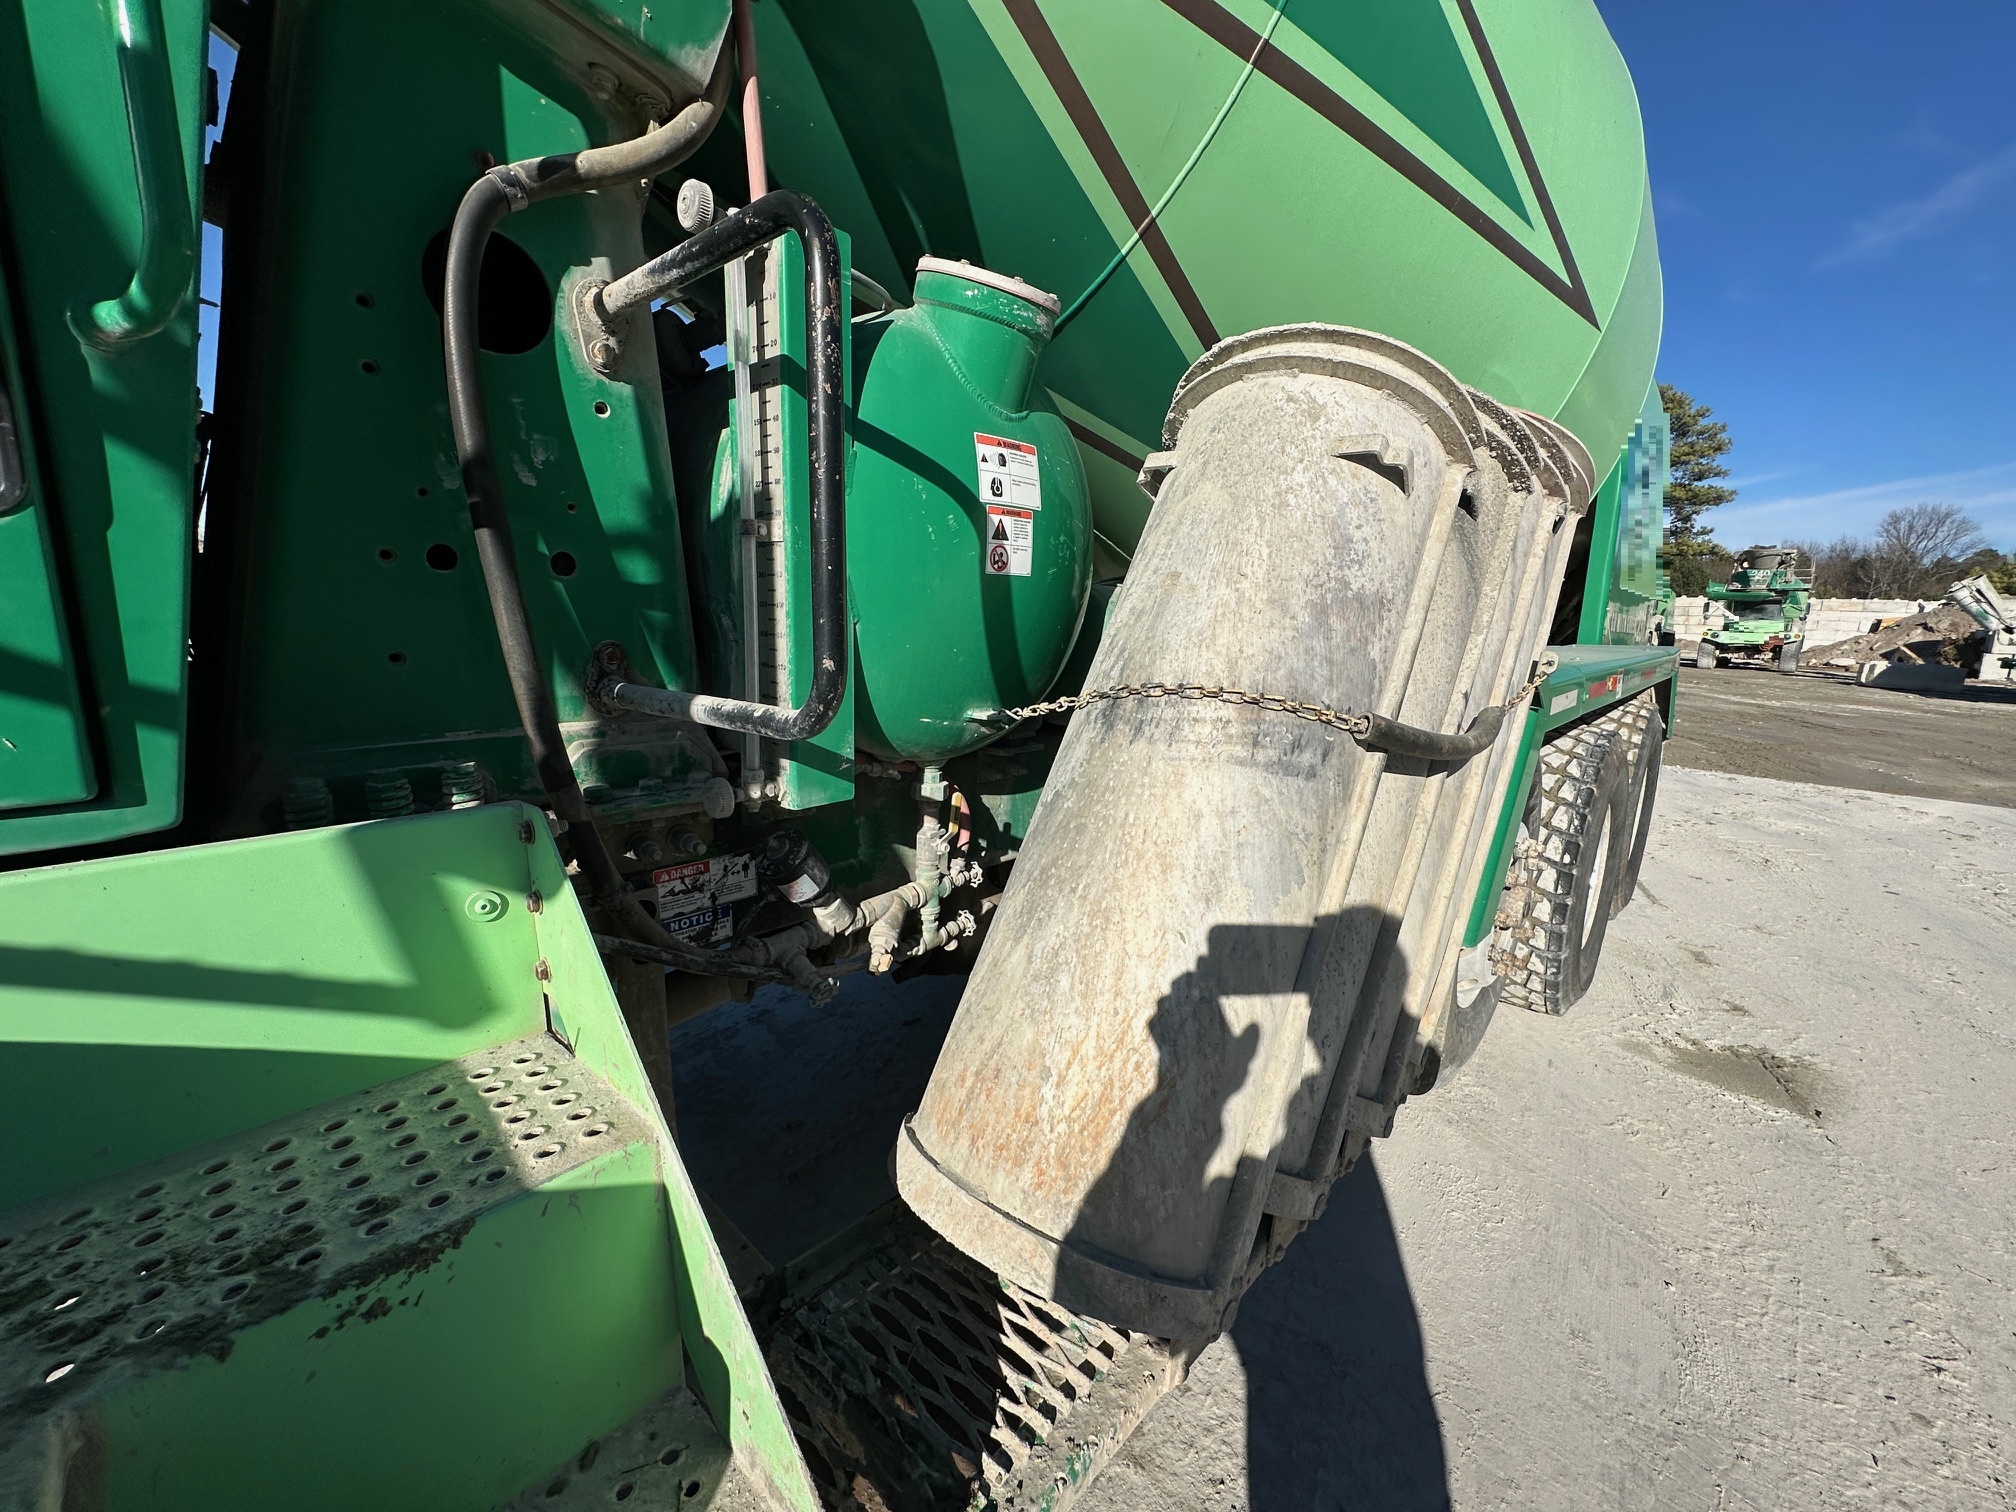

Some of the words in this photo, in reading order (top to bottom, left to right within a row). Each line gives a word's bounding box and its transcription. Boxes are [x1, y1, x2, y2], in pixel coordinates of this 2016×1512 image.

[769, 292, 776, 300] 10
[770, 339, 777, 348] 20
[773, 414, 779, 422] 40
[670, 864, 704, 878] DANGER
